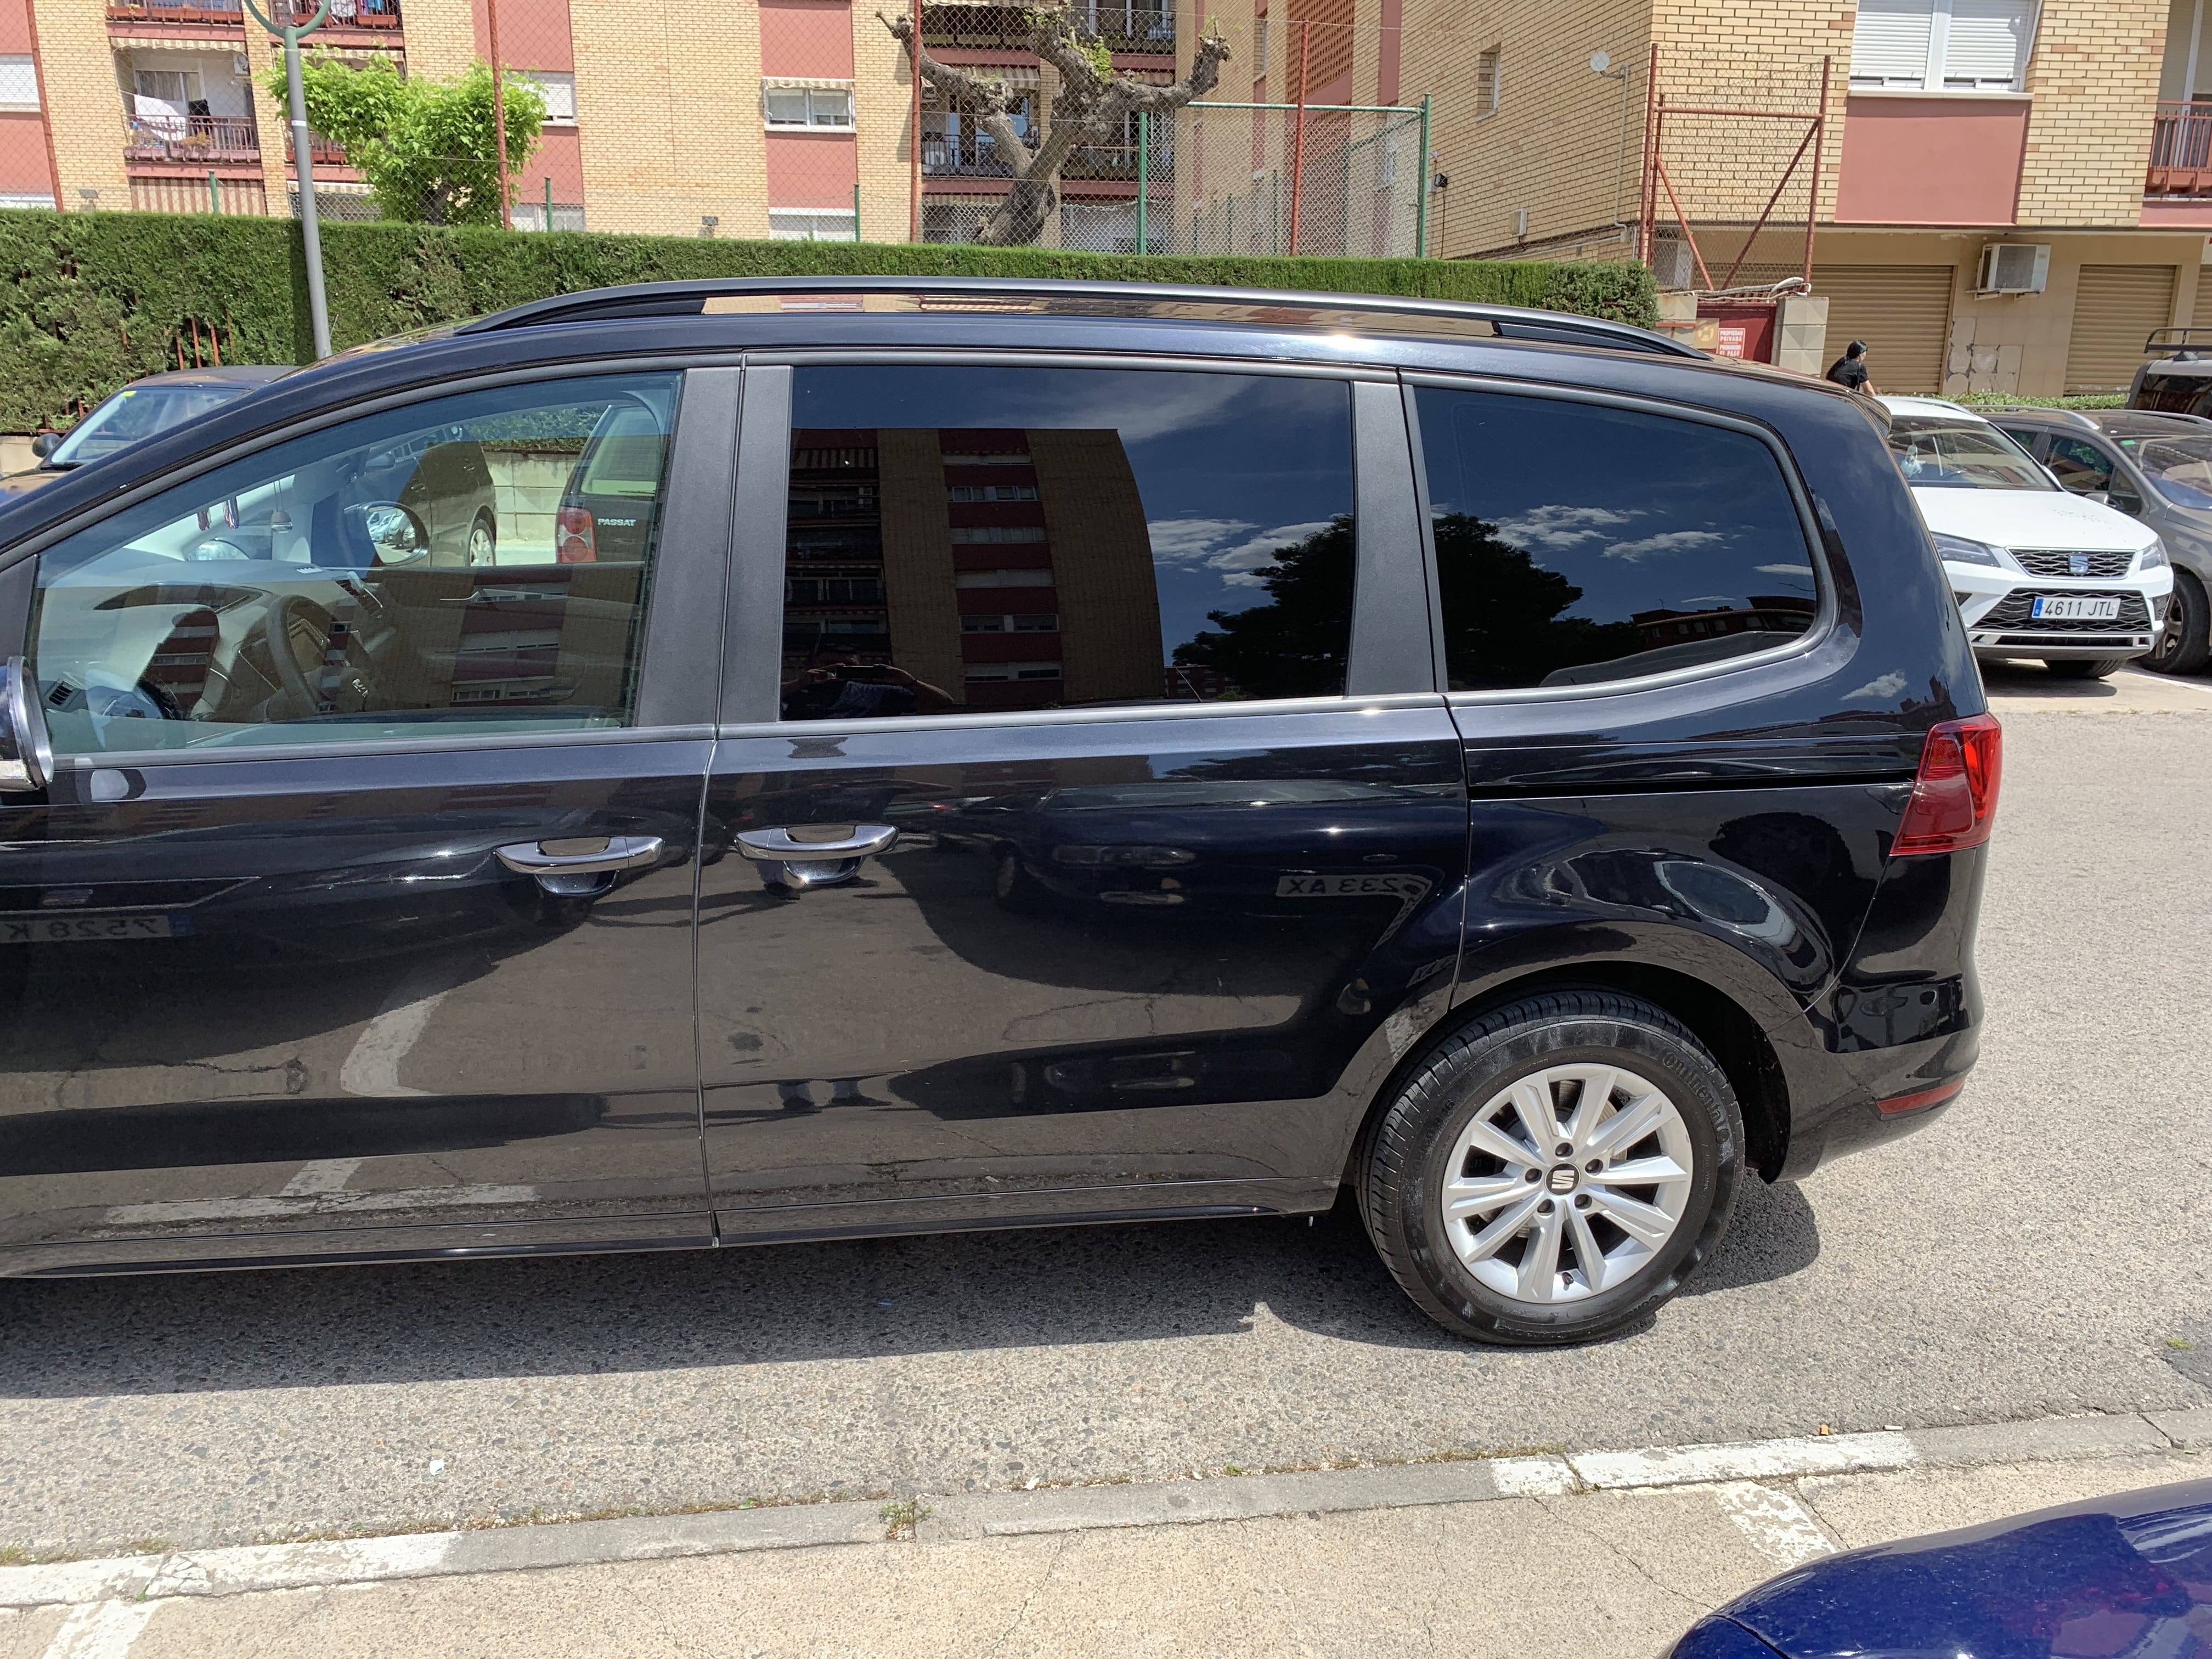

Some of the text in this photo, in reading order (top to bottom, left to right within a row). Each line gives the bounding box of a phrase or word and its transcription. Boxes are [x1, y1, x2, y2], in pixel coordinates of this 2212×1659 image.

[597, 518, 636, 526] PASSAT
[2045, 601, 2114, 616] 4611 JTL
